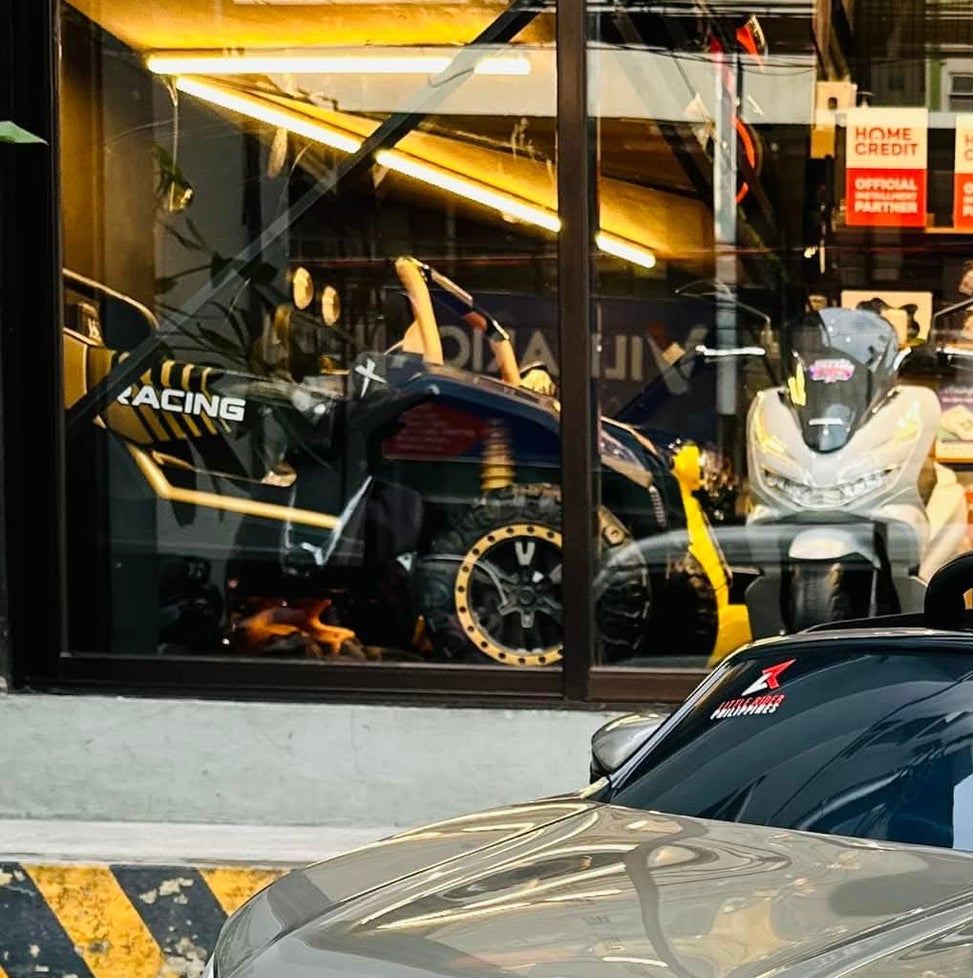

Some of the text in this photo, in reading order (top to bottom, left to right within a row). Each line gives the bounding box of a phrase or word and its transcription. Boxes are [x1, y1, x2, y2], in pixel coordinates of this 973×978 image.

[855, 127, 912, 140] HOME
[855, 143, 918, 156] CREDIT
[854, 177, 918, 191] OFFICIAL
[854, 200, 918, 213] PARTNER
[717, 694, 785, 710] LITTLE RIDER
[710, 703, 780, 720] PHILIPPINES
